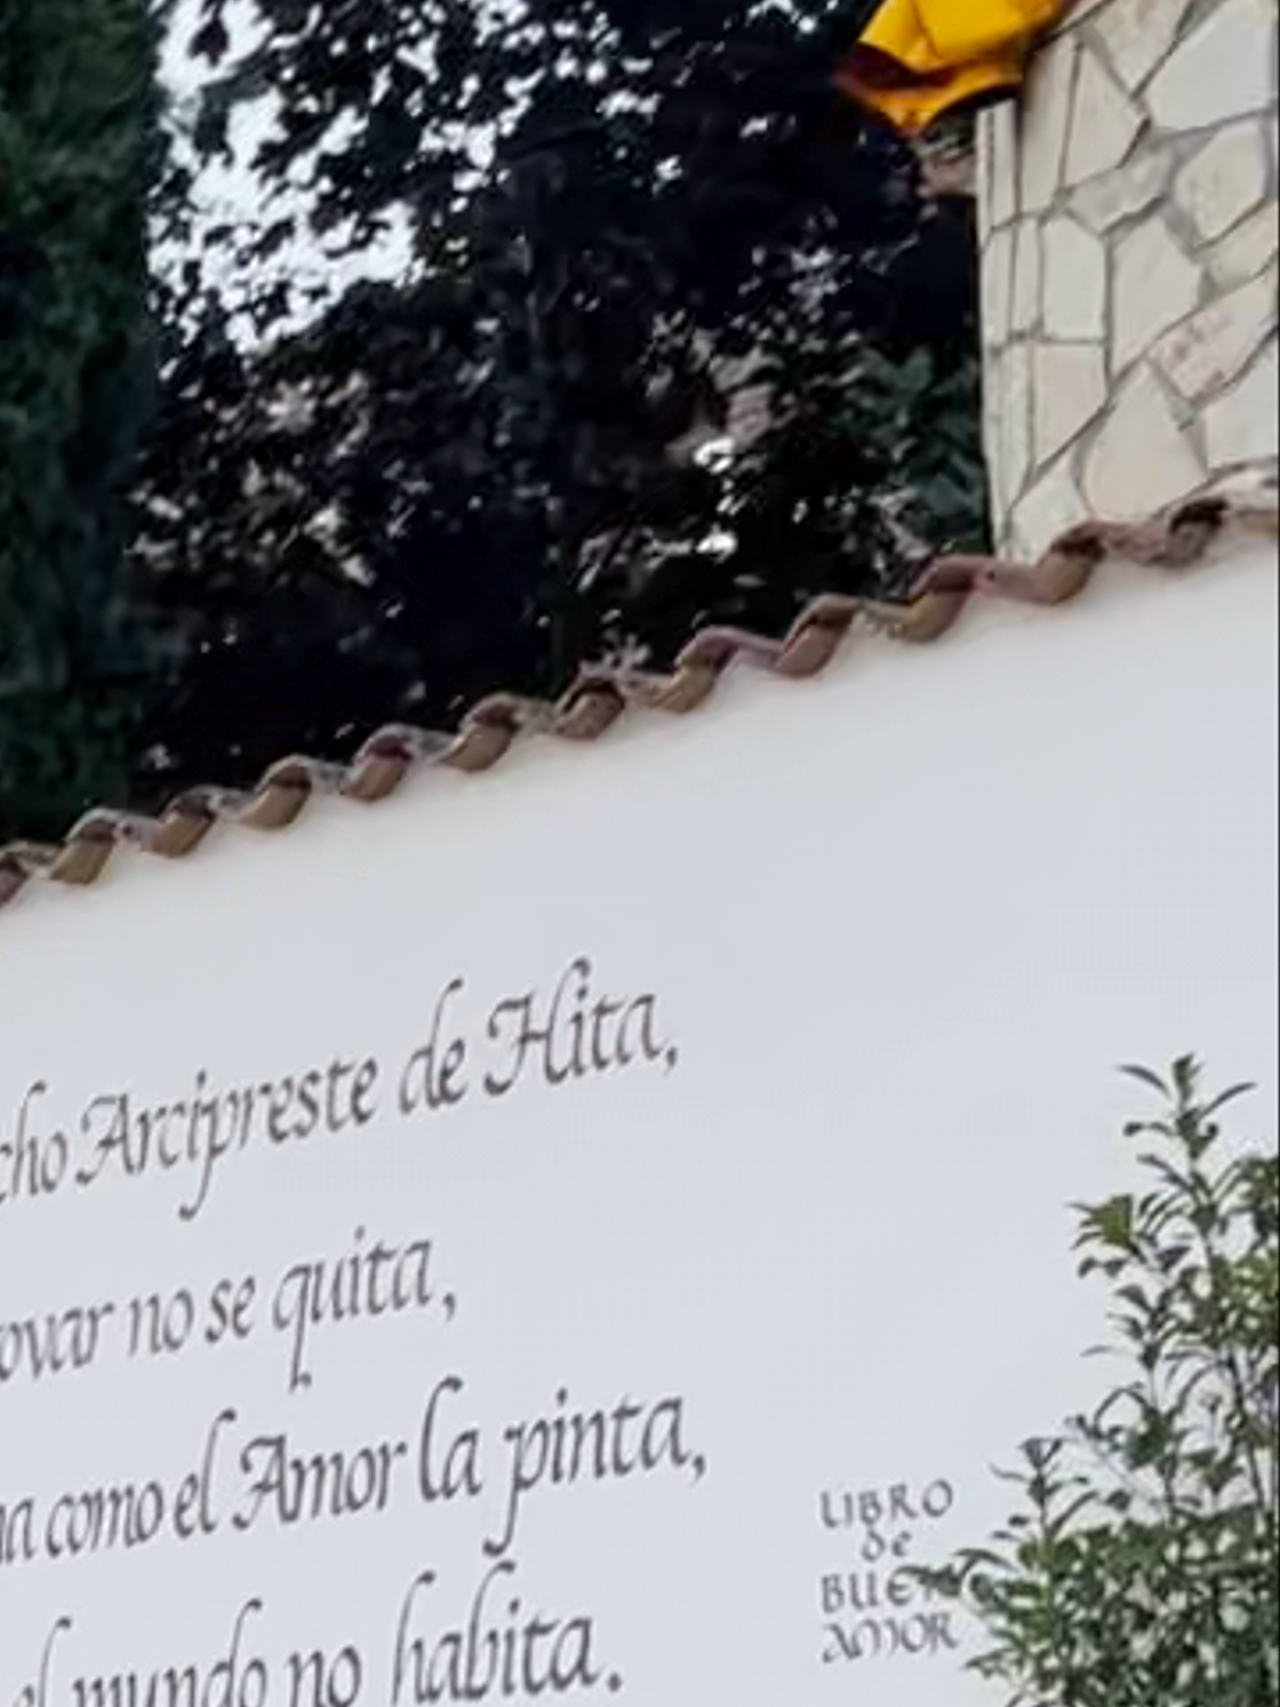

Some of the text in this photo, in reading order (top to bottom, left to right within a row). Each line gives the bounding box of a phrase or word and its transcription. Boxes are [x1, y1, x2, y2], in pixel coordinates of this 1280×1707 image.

[74, 1058, 378, 1222] Arcipreste
[399, 977, 468, 1116] de
[483, 957, 678, 1098] Hita,
[128, 1288, 195, 1358] no
[203, 1276, 256, 1345] se
[272, 1225, 457, 1394] quita,
[44, 1481, 165, 1560] como
[173, 1408, 238, 1540] el
[230, 1431, 409, 1532] Amor
[419, 1374, 484, 1504] la
[482, 1386, 707, 1558] pinta,
[820, 1477, 955, 1530] LIBRO
[390, 1559, 624, 1707] habita.
[821, 1611, 961, 1664] AMOR
